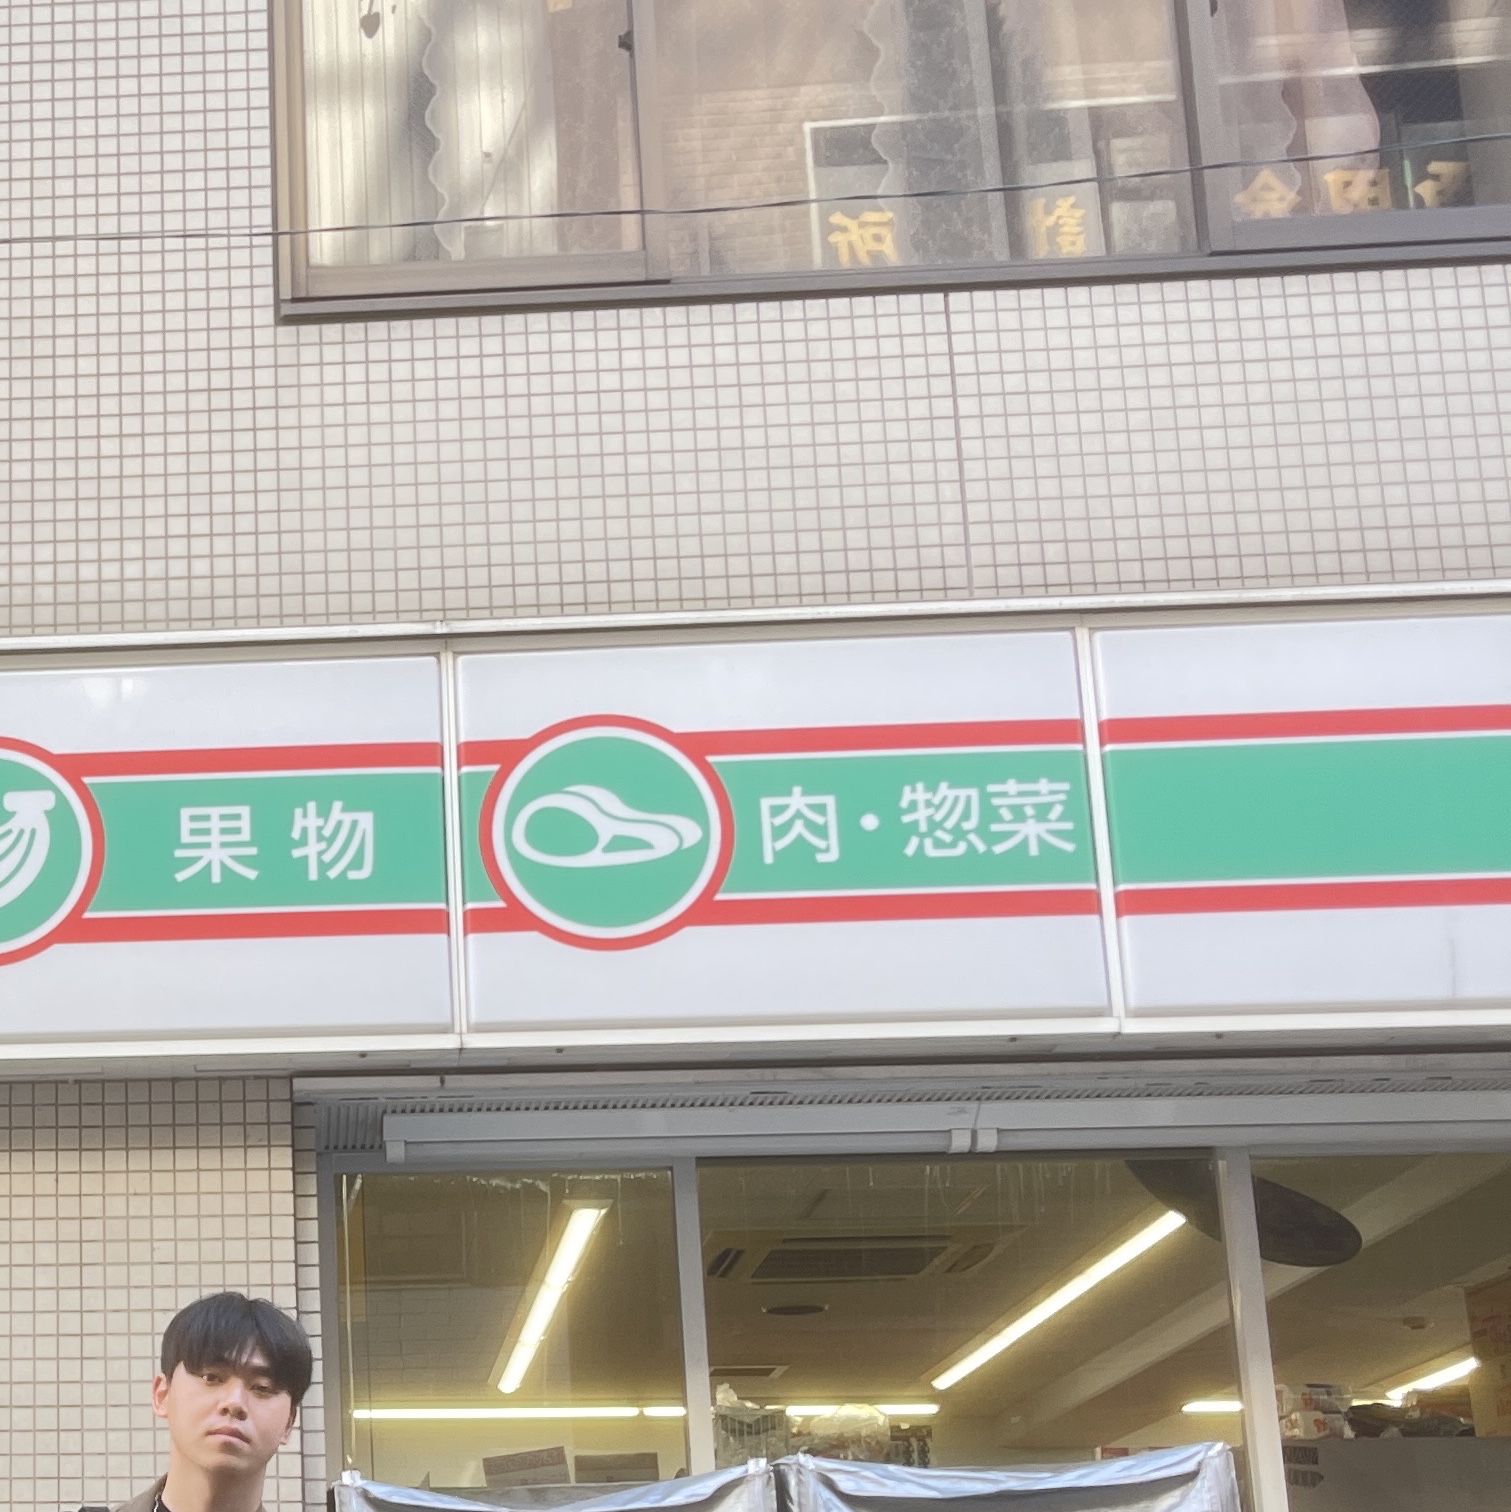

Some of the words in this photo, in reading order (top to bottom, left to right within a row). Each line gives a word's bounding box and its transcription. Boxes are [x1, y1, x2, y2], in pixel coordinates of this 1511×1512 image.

[173, 800, 375, 884] 果物
[760, 778, 1076, 864] 肉・惣菜
